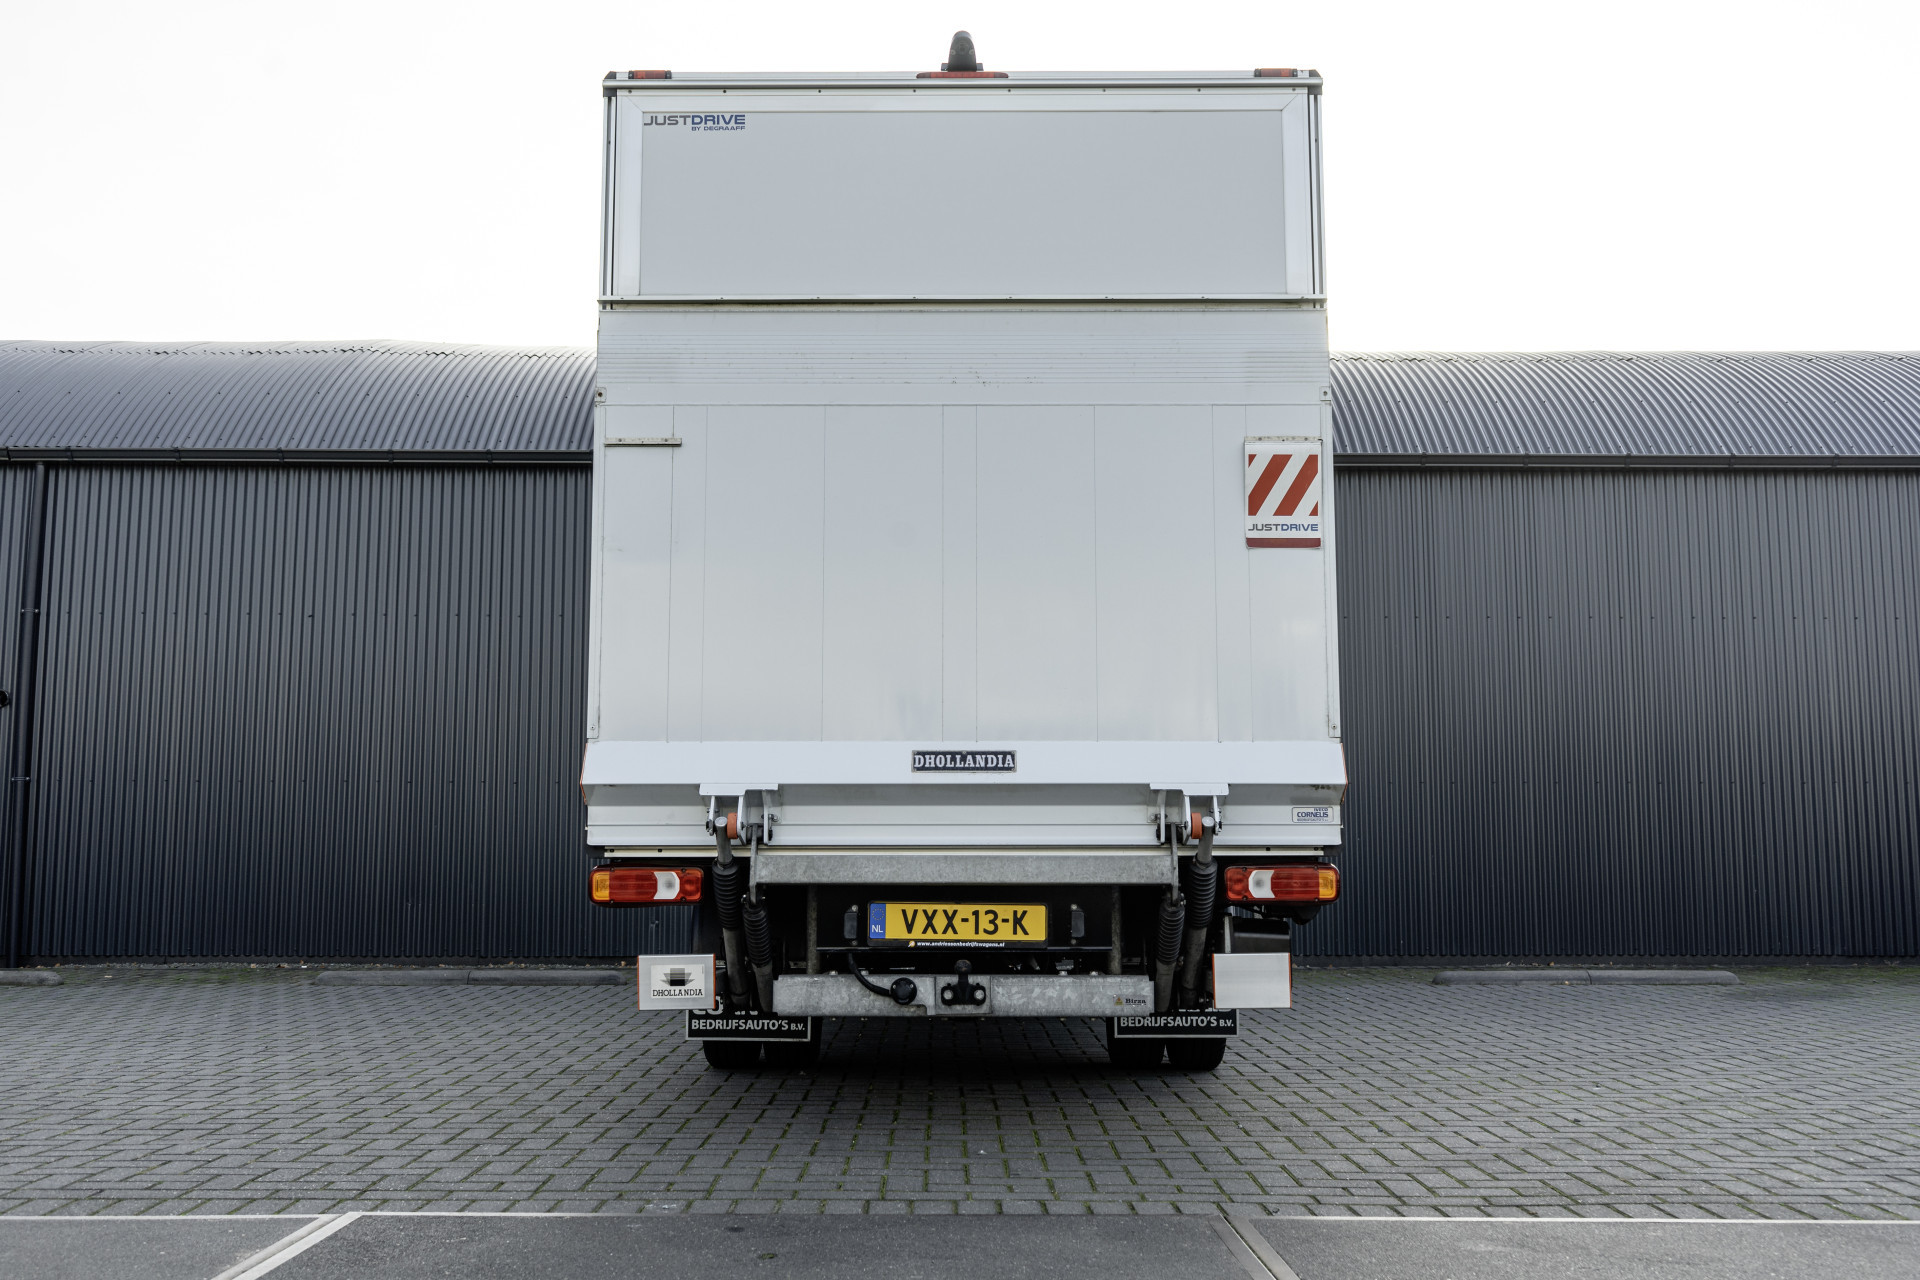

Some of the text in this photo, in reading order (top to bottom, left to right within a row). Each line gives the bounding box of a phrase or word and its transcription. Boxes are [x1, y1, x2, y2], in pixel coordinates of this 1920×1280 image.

[643, 115, 745, 126] JUSTDRIVE
[1248, 523, 1319, 532] JUSTDRIVE
[913, 754, 1015, 768] DHOLLANDIA
[901, 908, 1030, 936] VXX-13-K
[871, 924, 884, 933] NL
[652, 988, 704, 998] DHOLLANDIA
[691, 1019, 806, 1031] BEDRIJFSAUTO'S B.V.
[1120, 1016, 1234, 1028] BEDRIJFSAUTO'S B.V.
